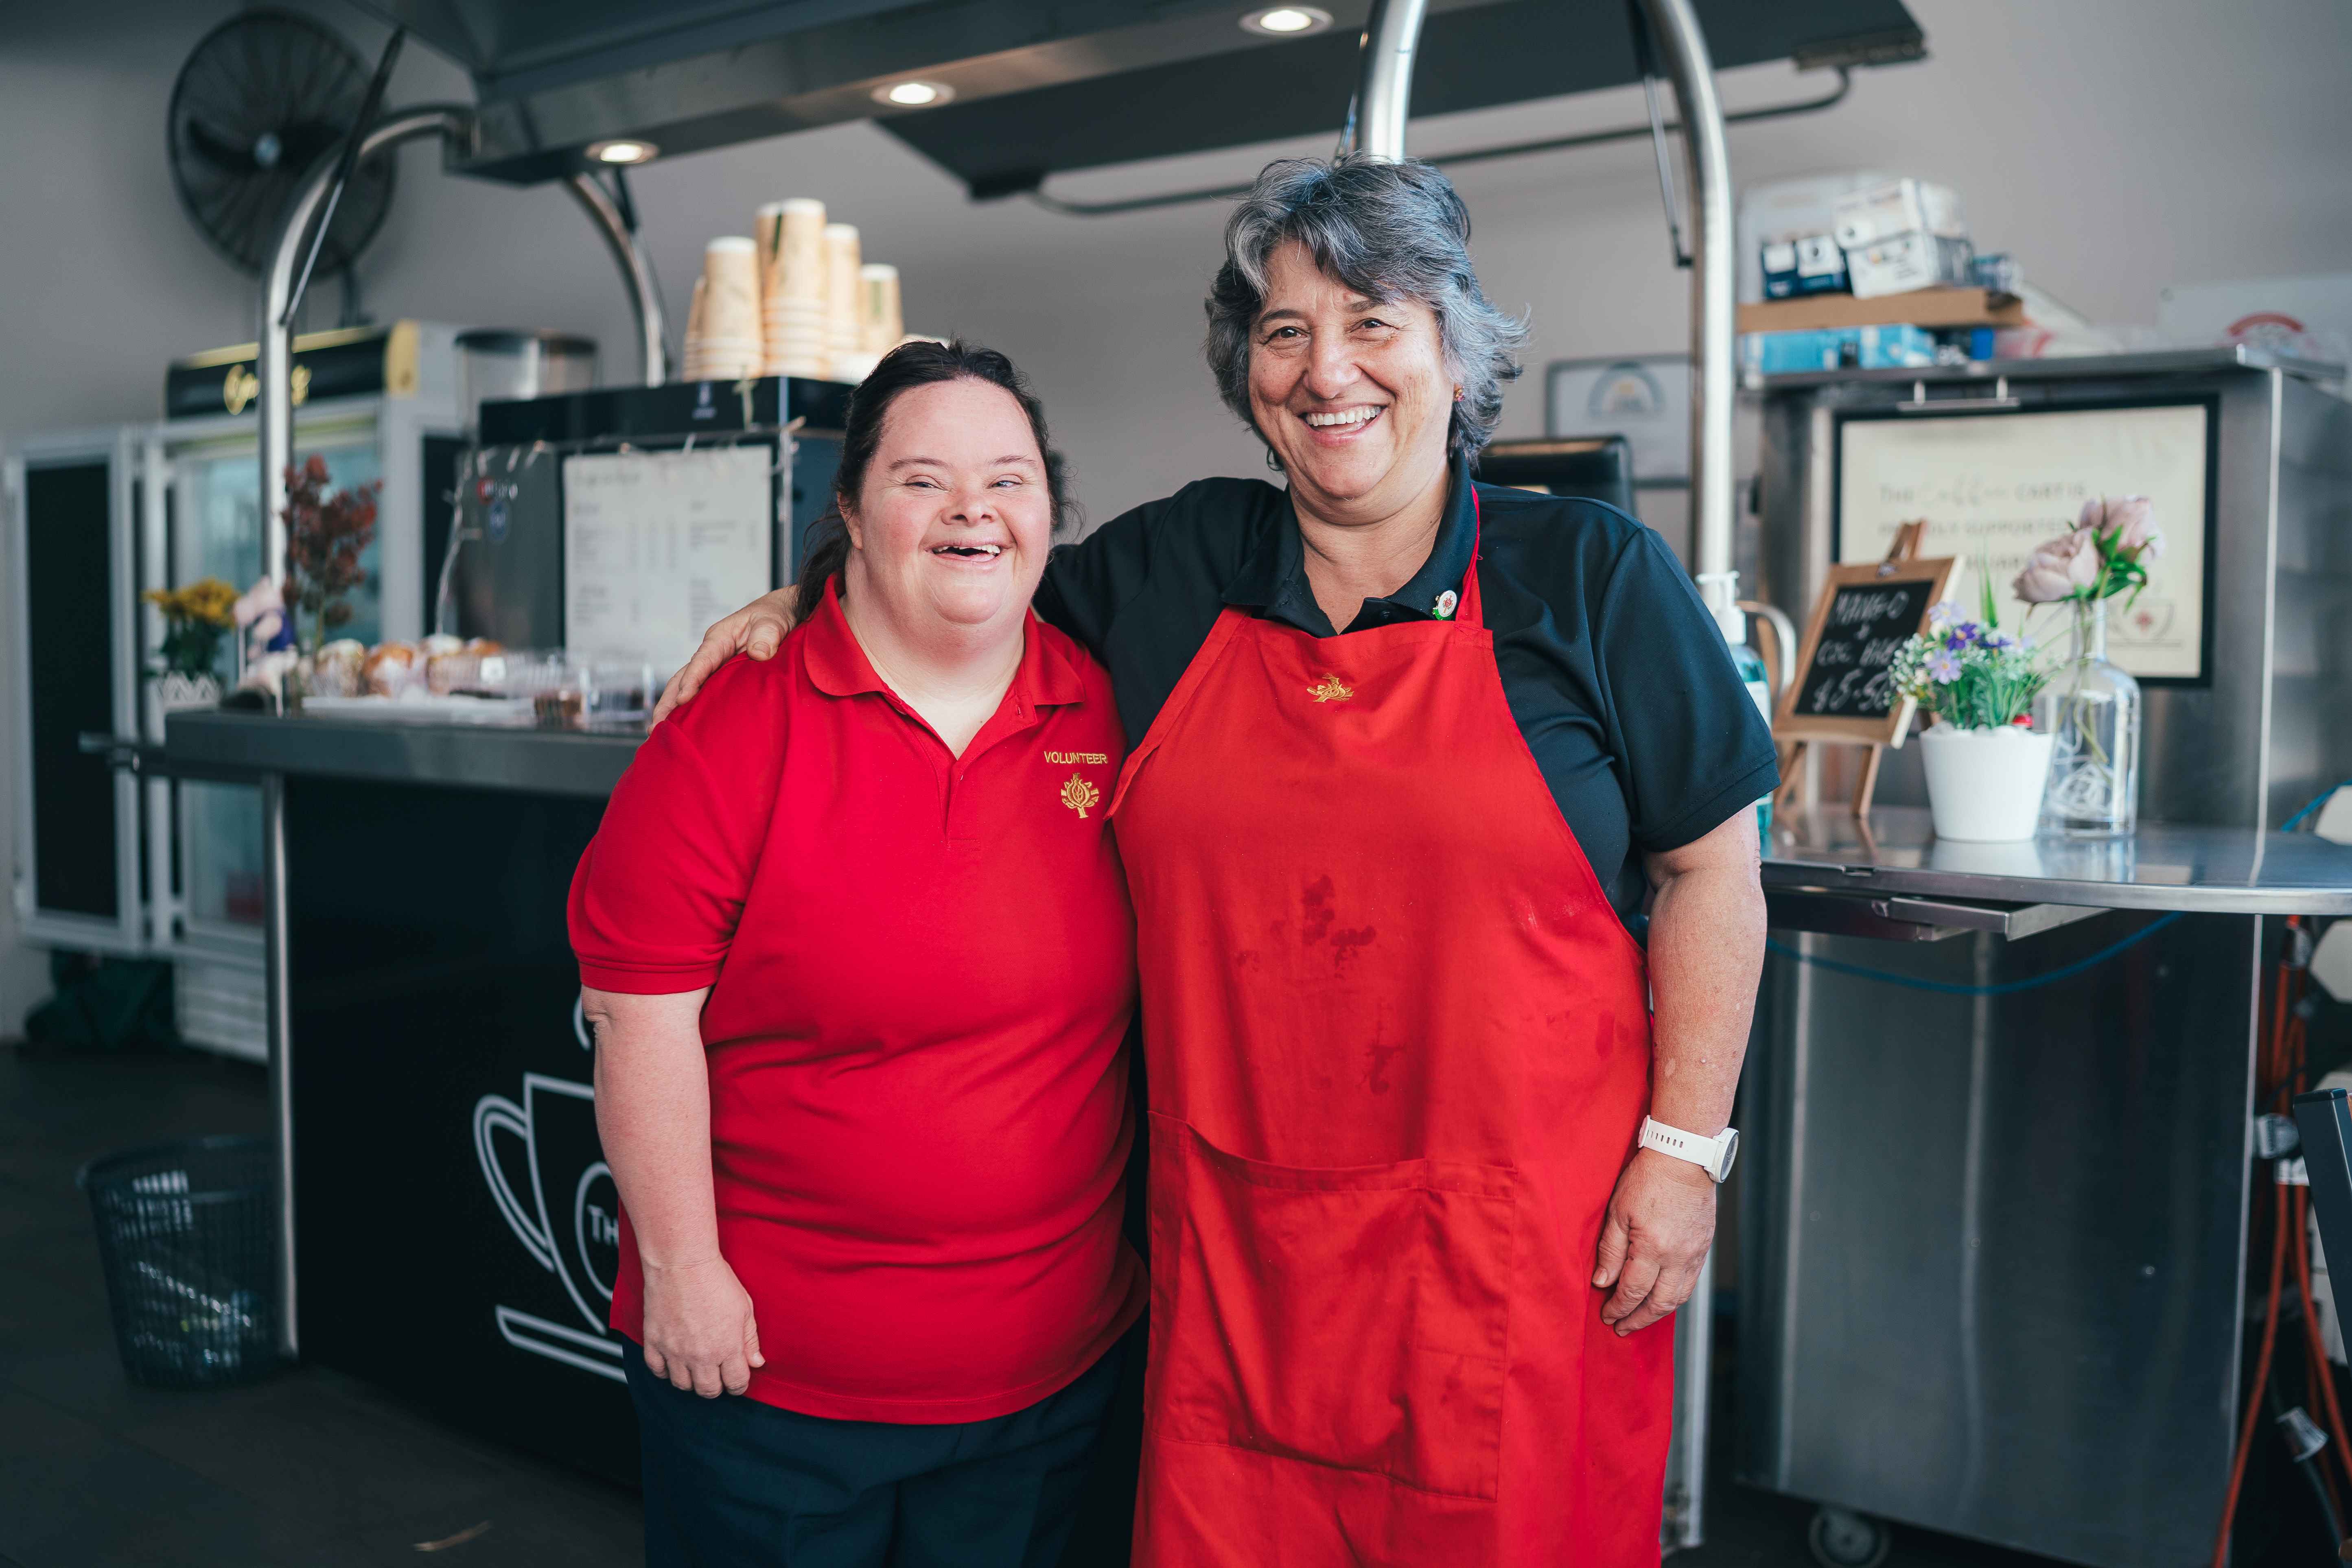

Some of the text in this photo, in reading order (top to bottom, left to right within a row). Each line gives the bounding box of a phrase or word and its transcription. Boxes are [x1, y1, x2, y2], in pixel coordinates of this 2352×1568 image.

[2014, 480, 2064, 502] CART
[2067, 479, 2087, 499] IS
[1044, 751, 1107, 764] VOLUNTEER
[587, 1205, 619, 1245] TH
